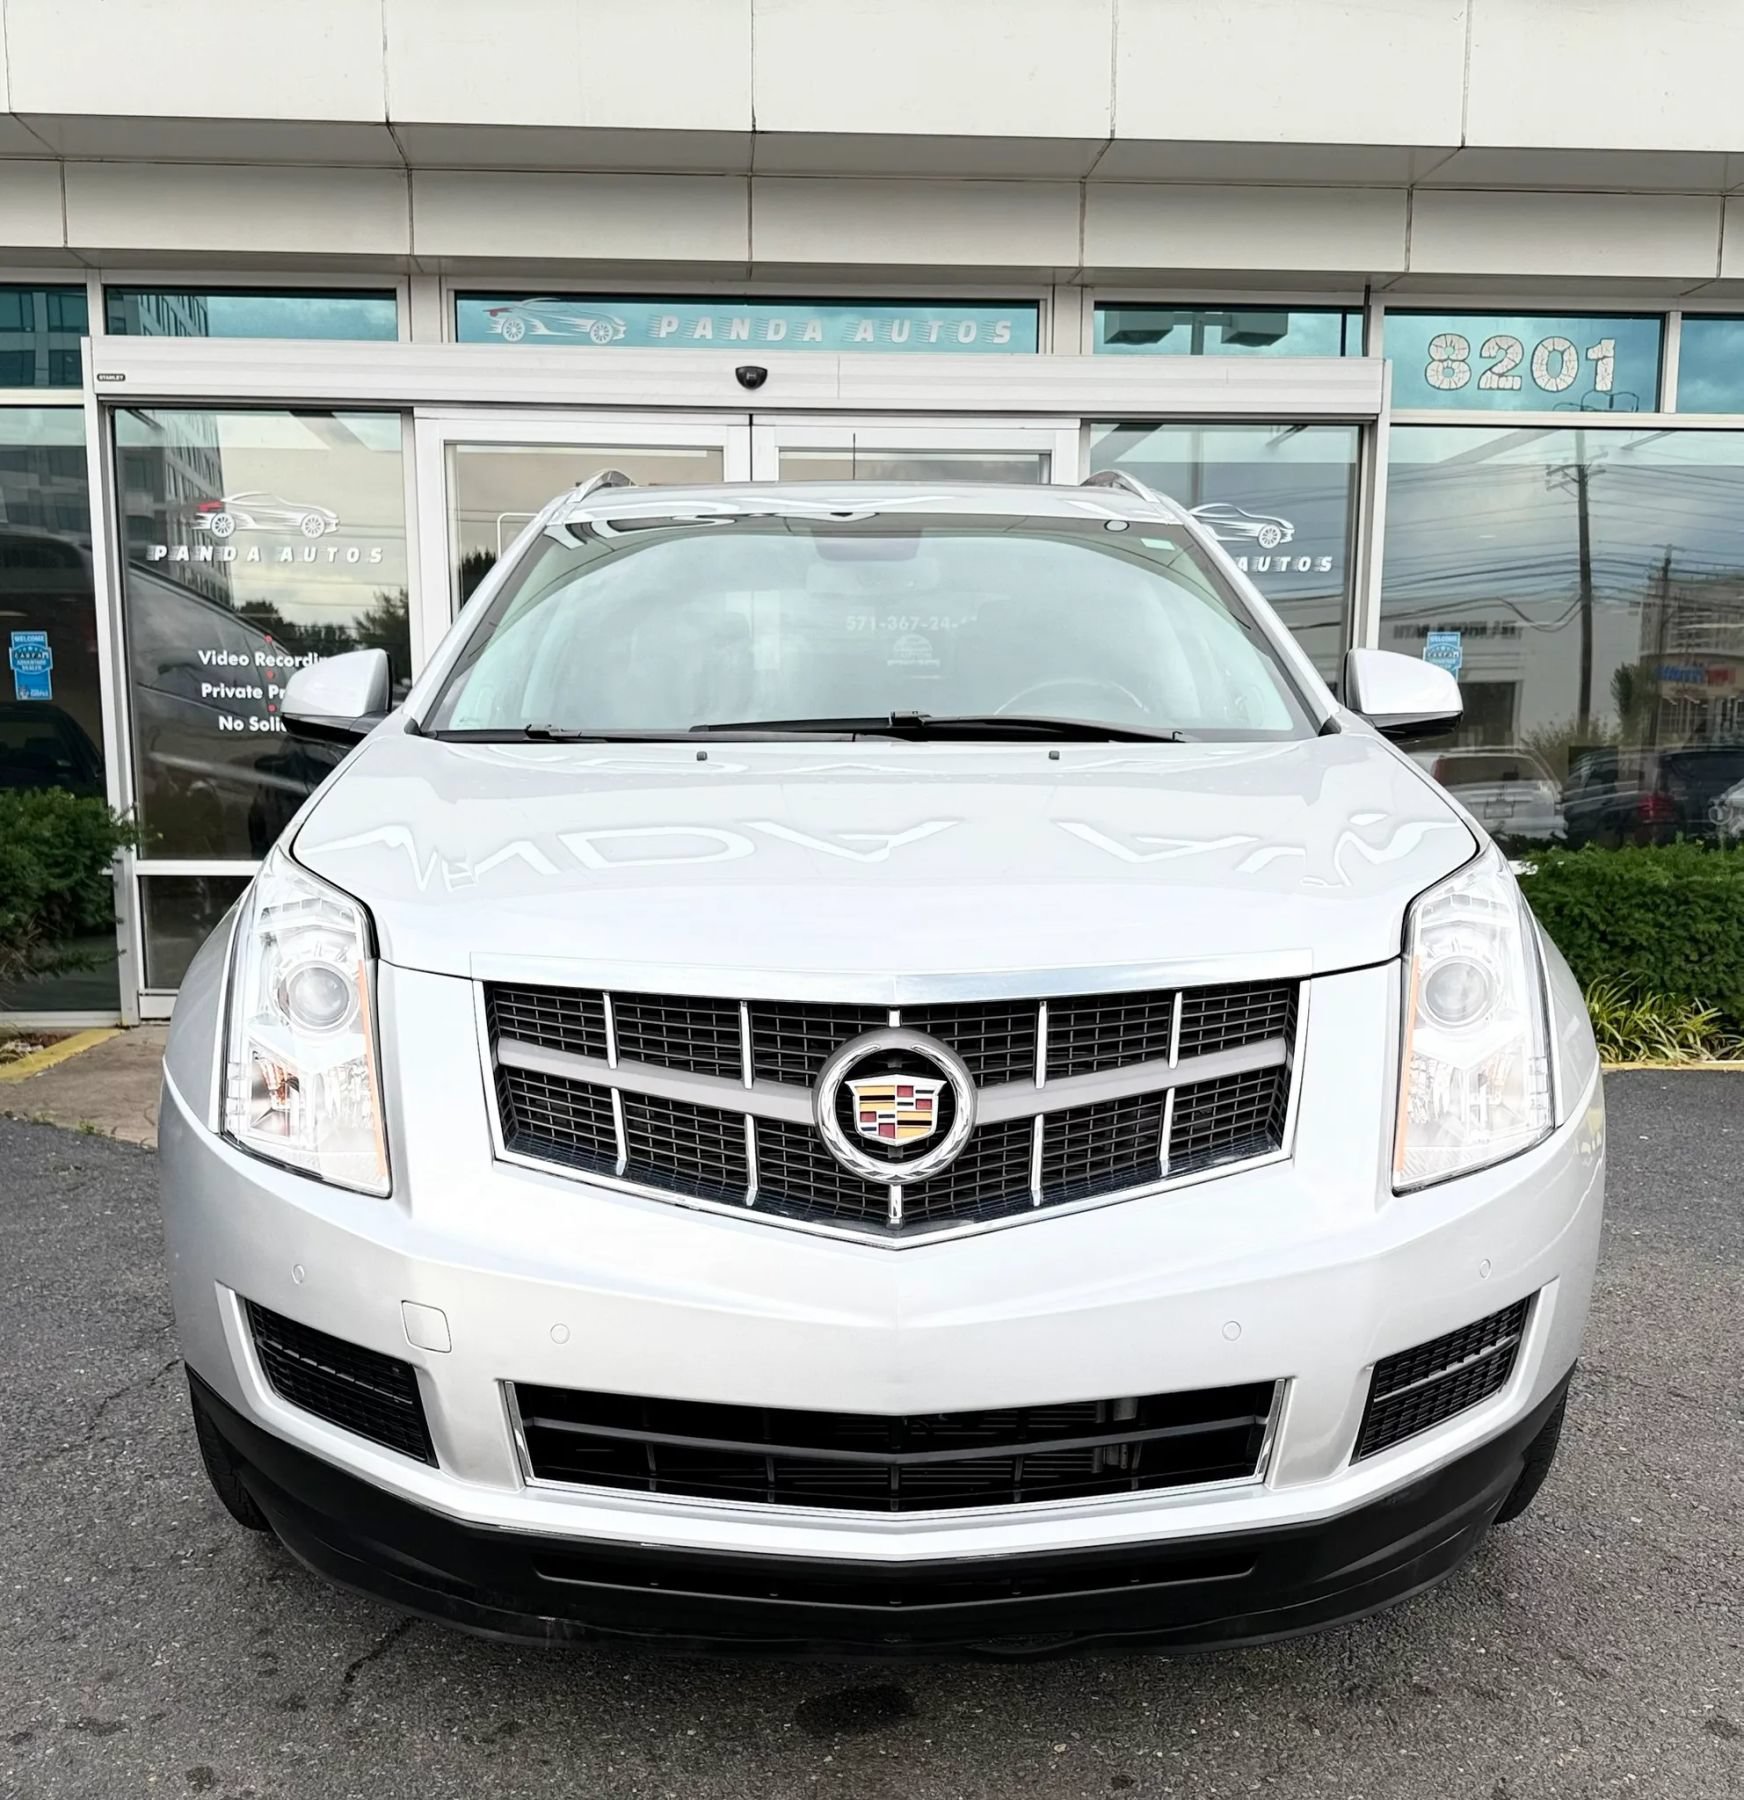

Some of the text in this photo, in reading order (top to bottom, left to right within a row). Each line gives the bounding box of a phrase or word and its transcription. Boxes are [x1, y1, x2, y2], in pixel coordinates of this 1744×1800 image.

[656, 315, 1012, 344] PANDA AUTOS
[1424, 333, 1616, 393] 8201
[151, 545, 383, 564] PANDA AUTOS
[1236, 556, 1333, 572] AUTOS
[198, 650, 328, 667] Video Recordi
[201, 683, 263, 699] Private
[219, 716, 244, 731] No
